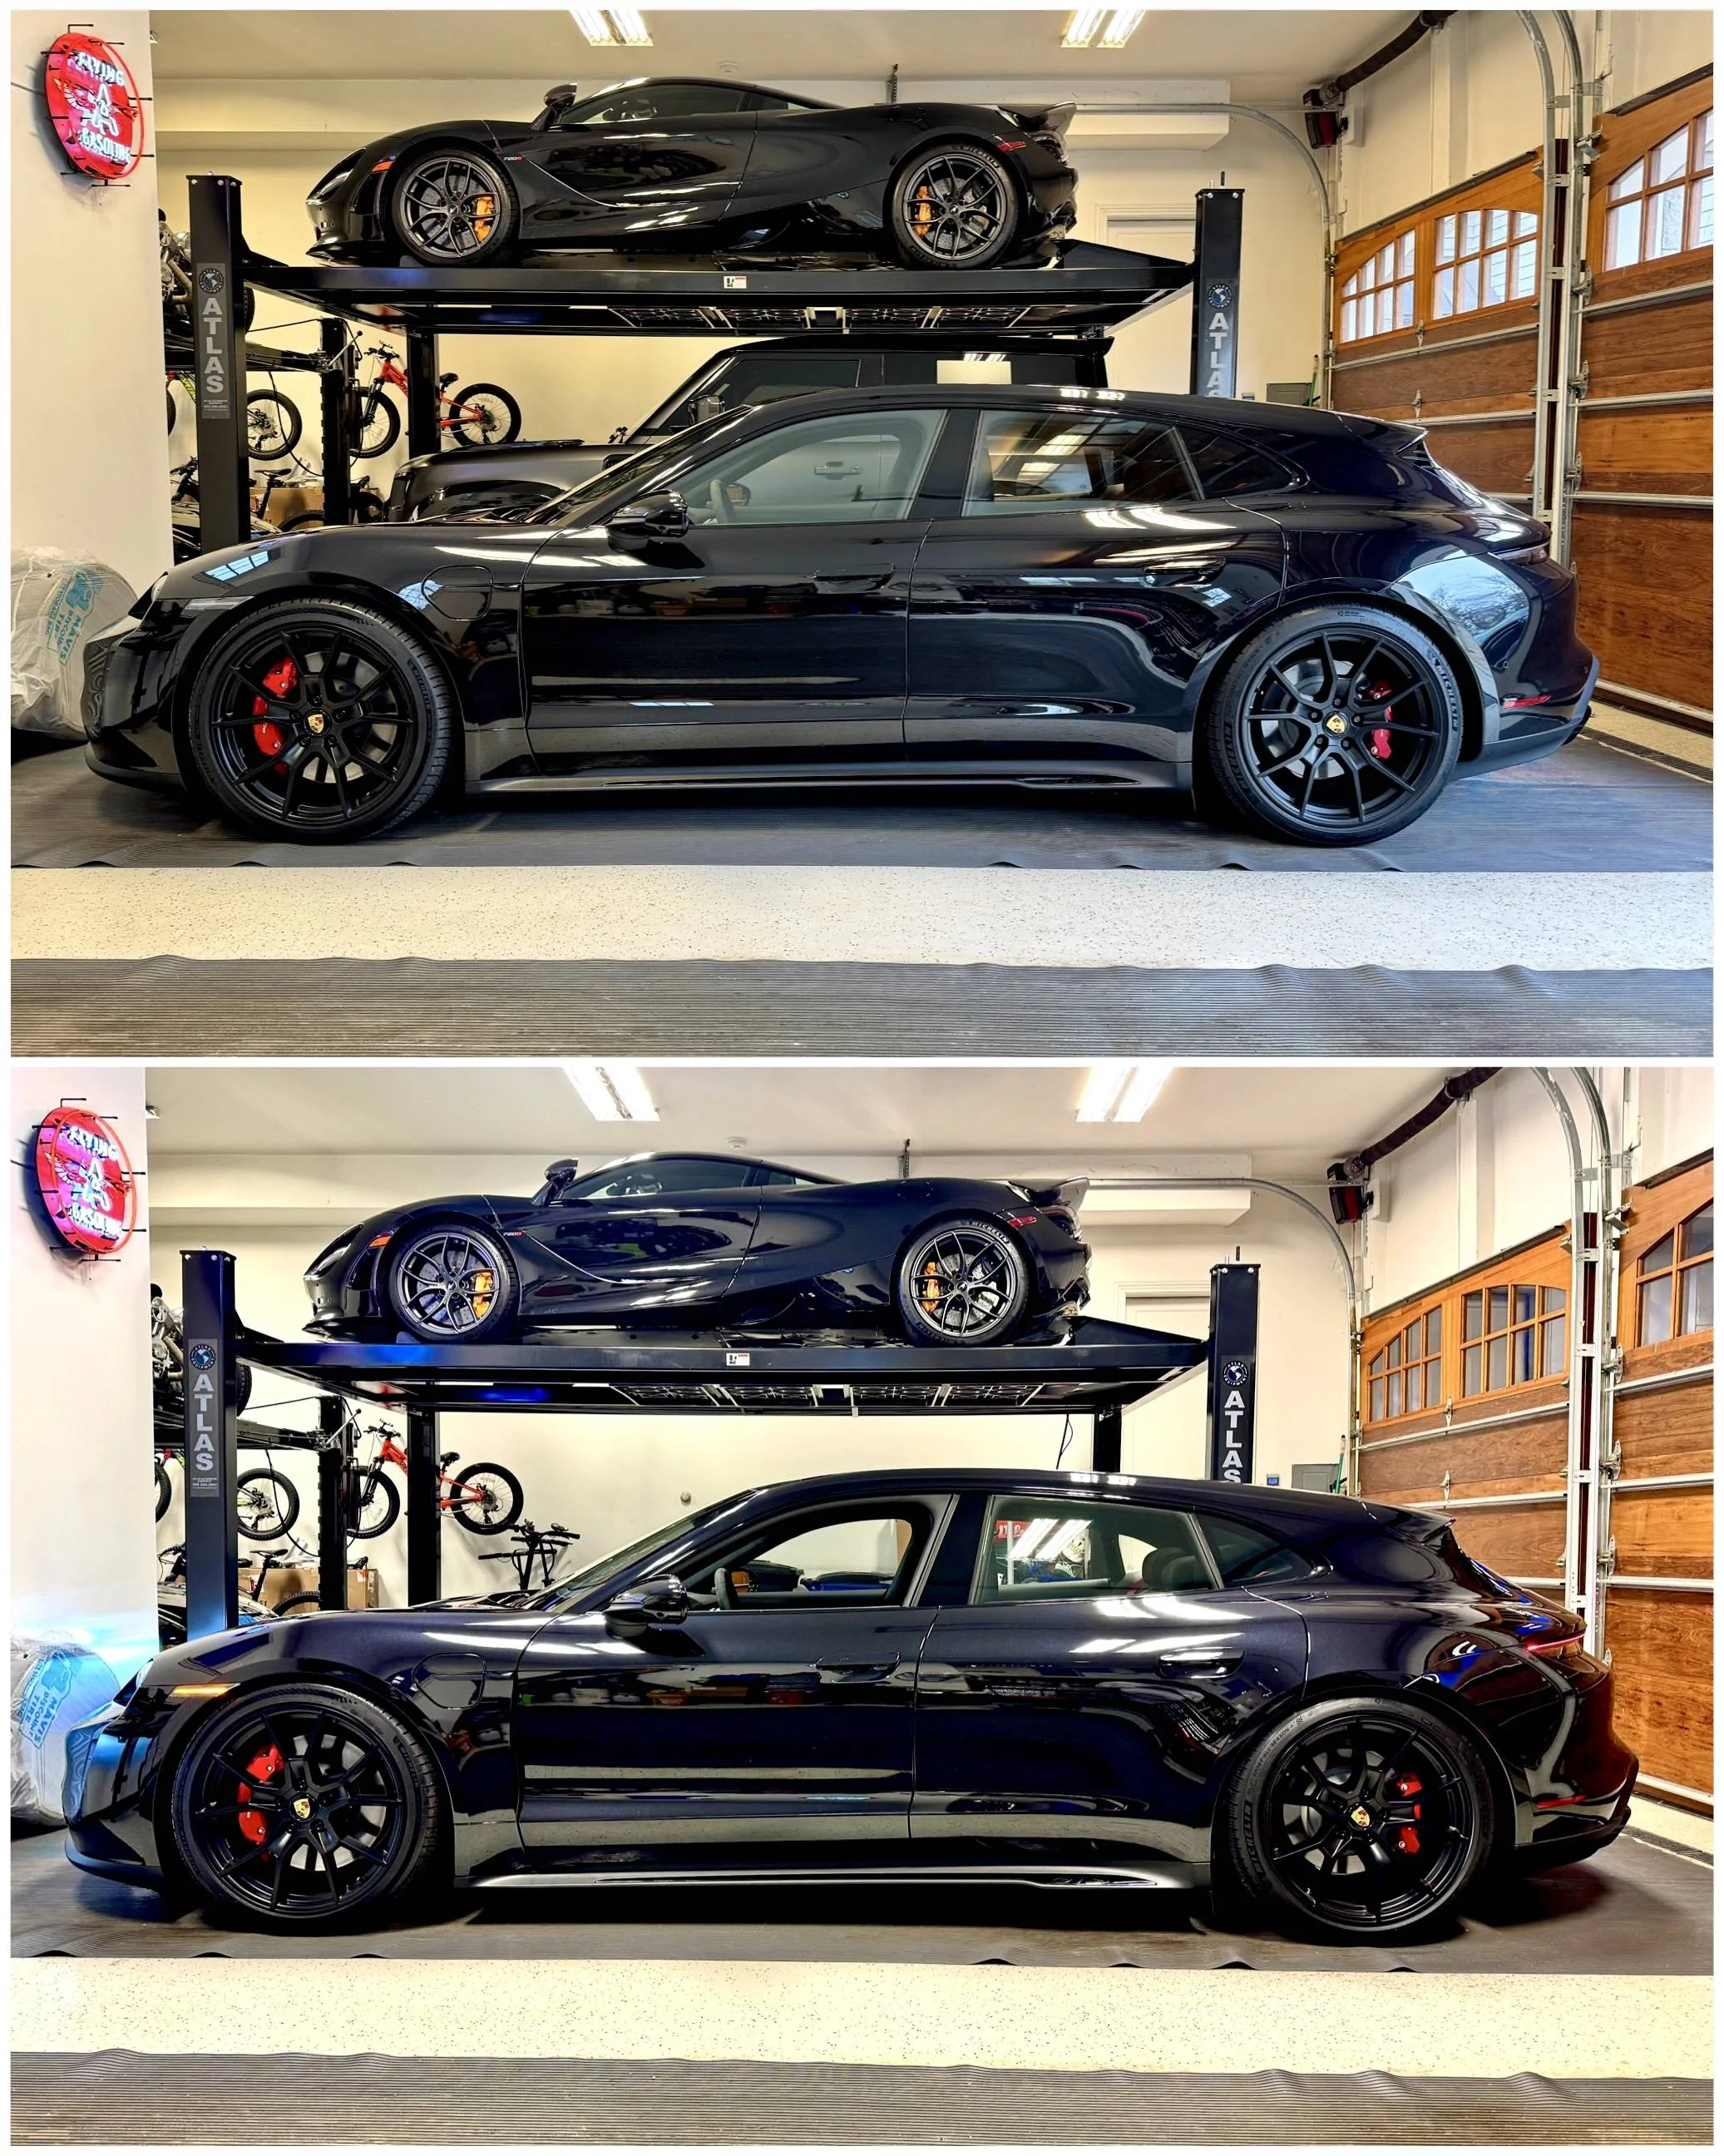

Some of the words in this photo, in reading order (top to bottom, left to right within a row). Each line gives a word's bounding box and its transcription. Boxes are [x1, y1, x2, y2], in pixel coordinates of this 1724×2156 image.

[72, 51, 125, 87] FLYING
[77, 127, 131, 166] GASOLINE
[962, 145, 1000, 168] MICHELIN
[202, 297, 225, 393] ATLAS
[59, 615, 82, 660] MAVIS
[1435, 665, 1460, 730] MICHELIN
[971, 1220, 1010, 1244] MICHELIN
[193, 1373, 215, 1471] ATLAS
[1222, 1390, 1245, 1483] ATLAS
[24, 1694, 41, 1723] TIRE
[28, 1691, 50, 1738] DISCOUNT
[34, 1696, 58, 1744] MAVIS
[1271, 1728, 1290, 1748] SEASON
[1244, 1804, 1263, 1873] MICHELIN
